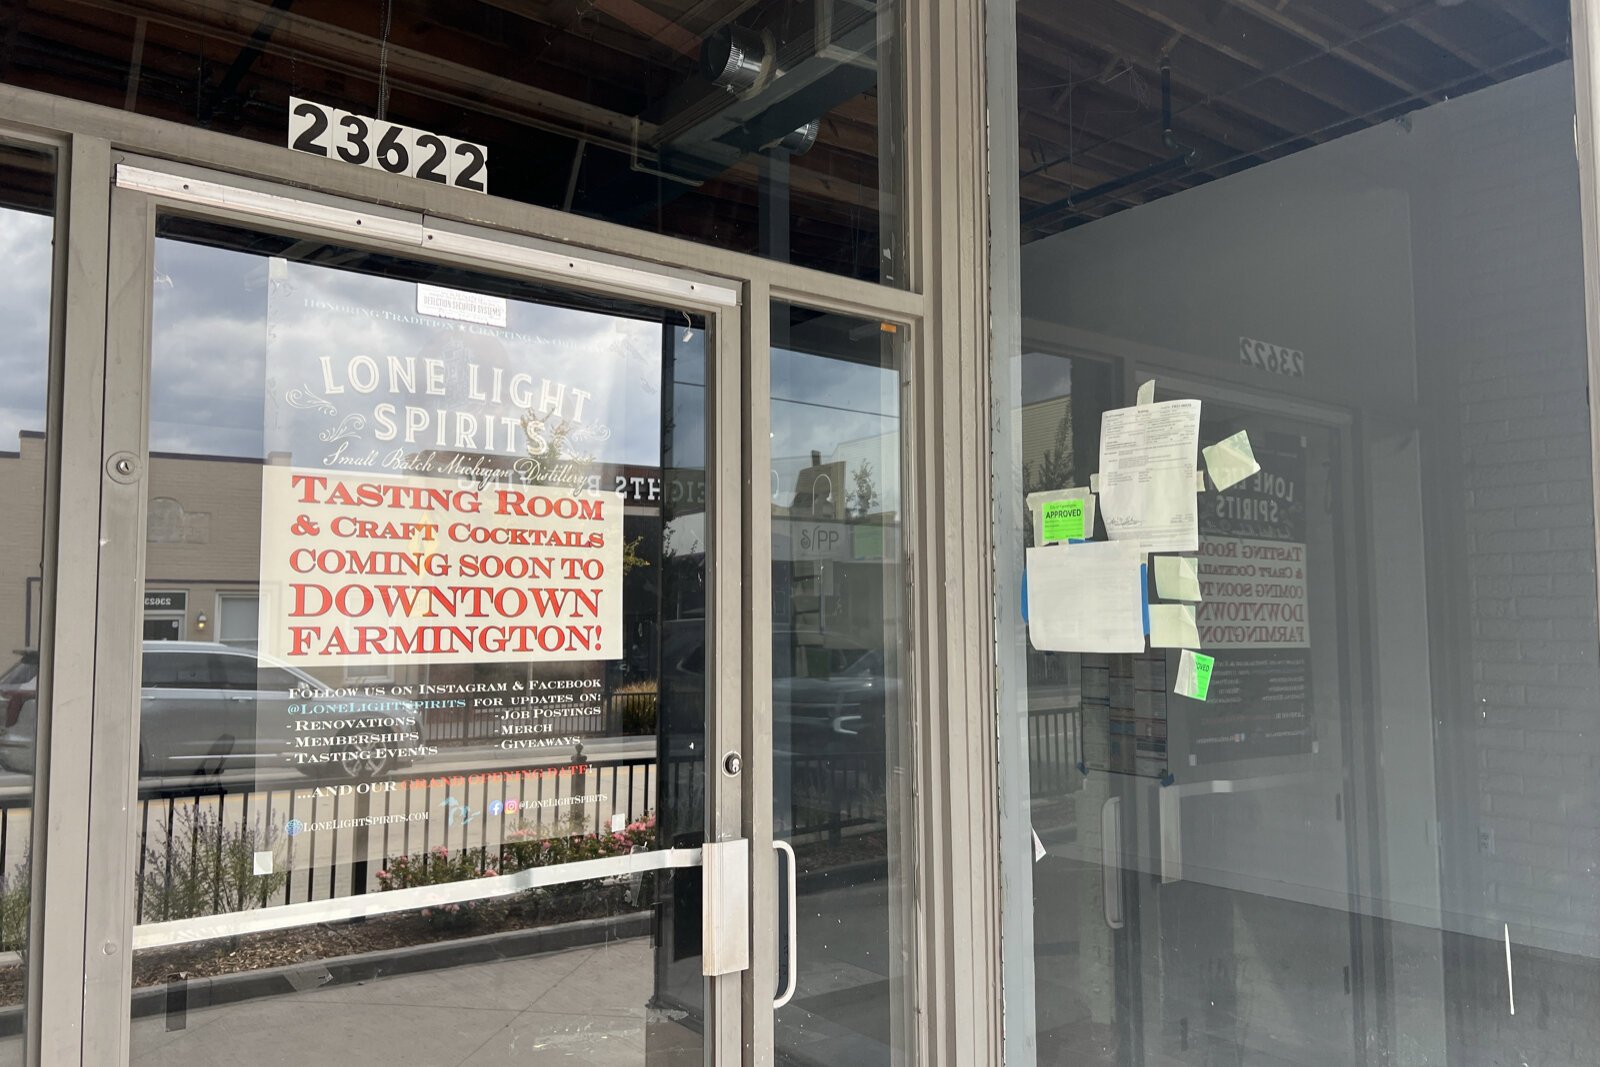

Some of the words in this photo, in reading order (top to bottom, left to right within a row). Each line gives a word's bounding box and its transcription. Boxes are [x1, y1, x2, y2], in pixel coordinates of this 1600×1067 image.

[293, 103, 484, 192] 23622
[304, 298, 379, 318] HONORING
[381, 310, 454, 330] TRADITION
[452, 300, 476, 313] SECURITY
[319, 355, 446, 394] LONE
[468, 364, 591, 423] LIGHT
[373, 403, 546, 454] SPIRITS
[323, 441, 375, 466] Small
[382, 449, 433, 473] Batch
[438, 455, 510, 491] Michigan
[513, 457, 590, 496] Distillery
[292, 475, 481, 513] TASTING
[495, 490, 605, 521] ROOM
[1045, 508, 1082, 519] APPROVED
[291, 514, 321, 536] &
[330, 516, 439, 541] CRAFT
[448, 523, 605, 548] COCKTAILS
[289, 548, 451, 577] COMING
[459, 555, 555, 579] SOON
[560, 558, 604, 580] TO
[288, 583, 603, 617] DOWNTOWN
[287, 625, 603, 656] FARMINGTON!
[288, 687, 359, 699] FOLLOW
[364, 686, 386, 696] US
[391, 685, 413, 695] ON
[419, 682, 507, 695] INSTAGRAM
[512, 680, 524, 691] &
[529, 679, 601, 690] FACEBOOK
[474, 698, 503, 707] FOR
[511, 694, 573, 705] UPDATES
[295, 716, 416, 731] RENOVATIONS
[501, 710, 530, 720] JOB
[533, 706, 601, 719] POSTINGS
[295, 732, 419, 748] MEMBERSHIPS
[501, 724, 553, 735] MERCH
[295, 750, 371, 764] TASTING
[375, 745, 438, 759] EVENTS
[501, 736, 581, 750] GIVEAWAYS
[356, 781, 398, 794] OUR
[468, 769, 543, 785] OPENING
